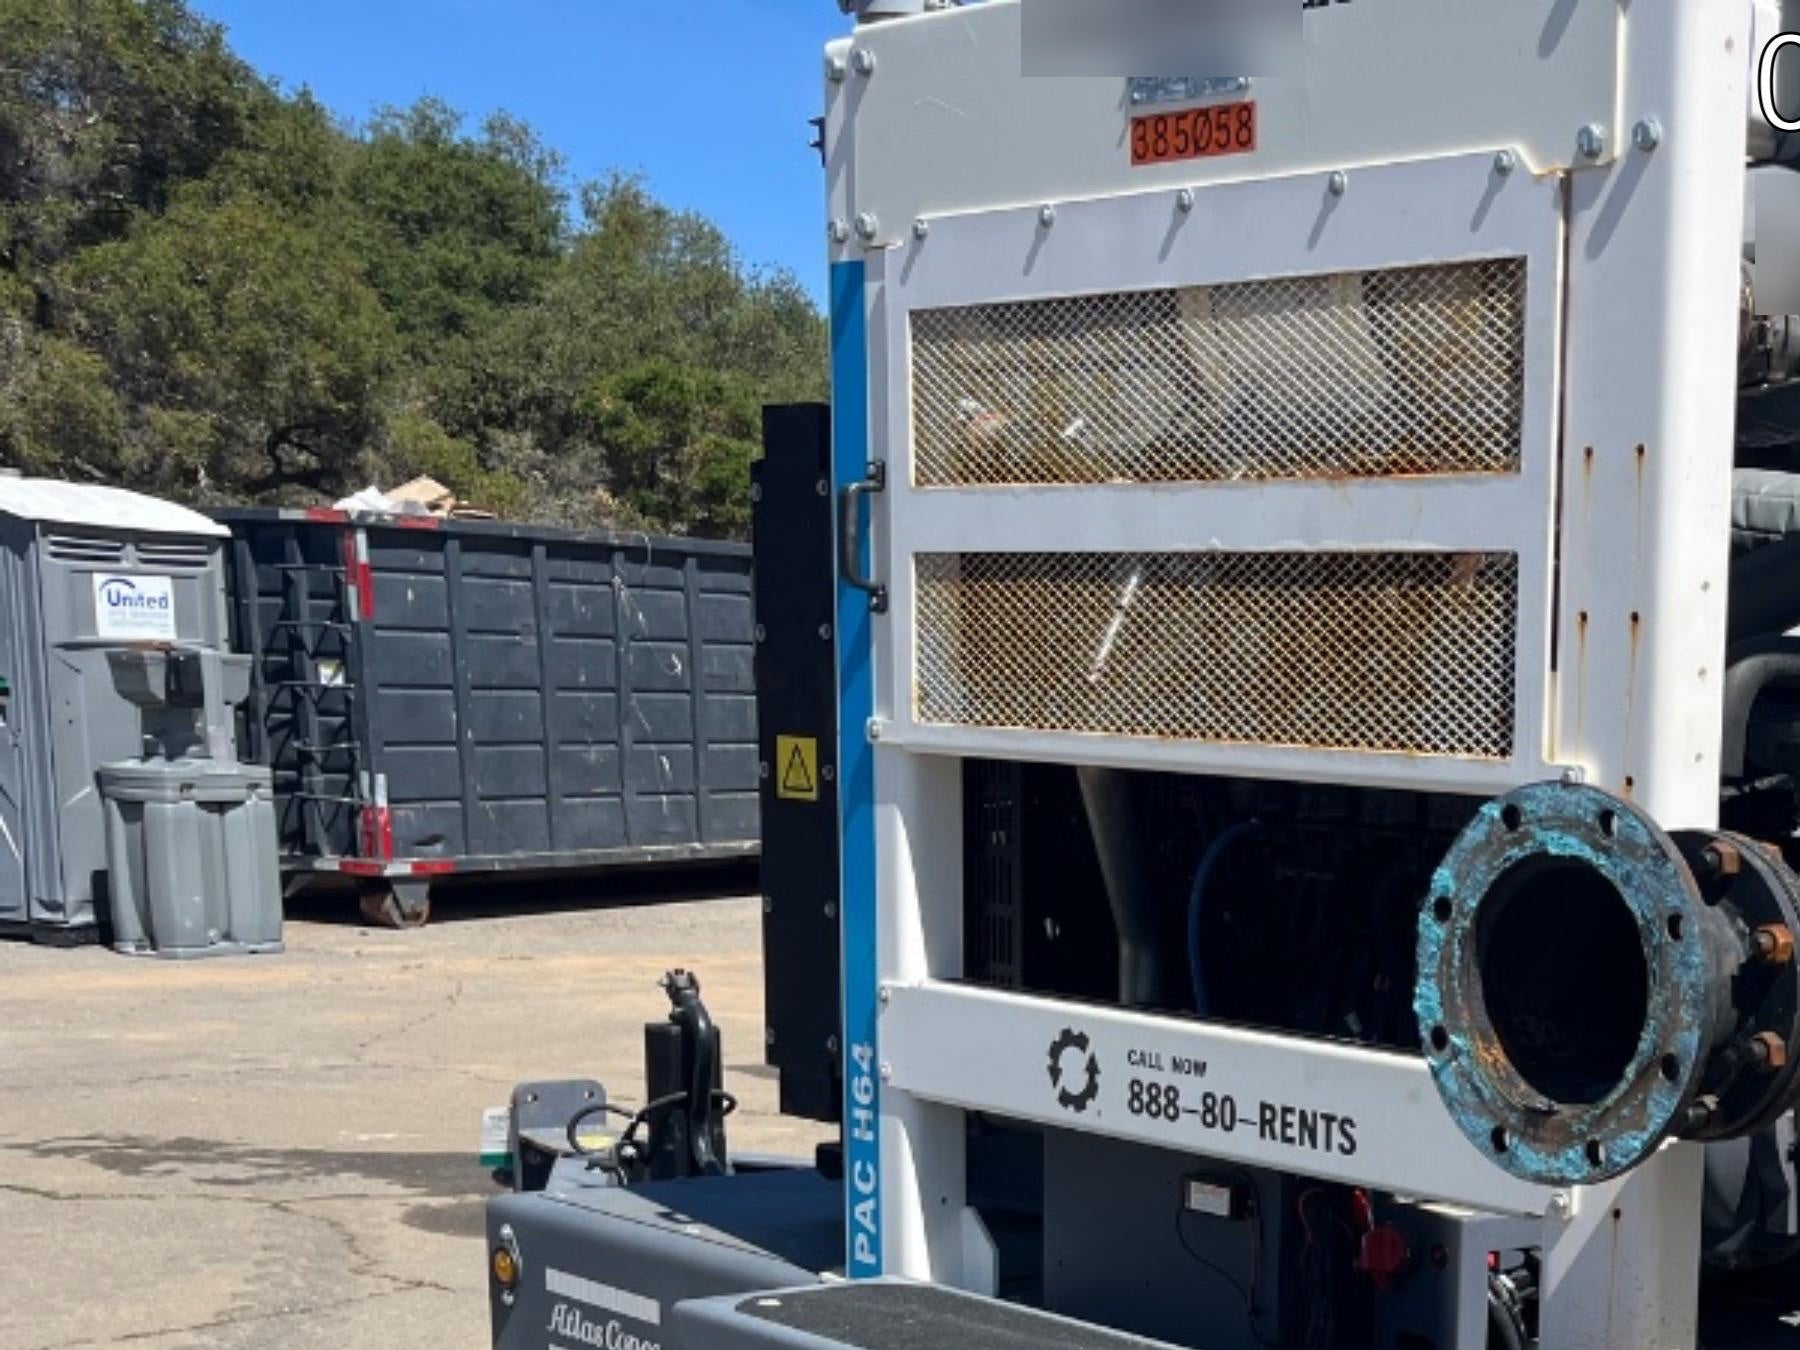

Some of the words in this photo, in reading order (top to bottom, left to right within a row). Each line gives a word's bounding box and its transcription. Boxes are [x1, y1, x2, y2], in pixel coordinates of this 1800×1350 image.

[107, 588, 169, 609] United
[852, 1040, 874, 1142] H64
[1127, 1049, 1164, 1073] CALL
[1172, 1056, 1208, 1078] NOW
[1128, 1078, 1358, 1156] 888-80-RENTS
[854, 1159, 878, 1266] PAC
[546, 1303, 603, 1348] Atlas
